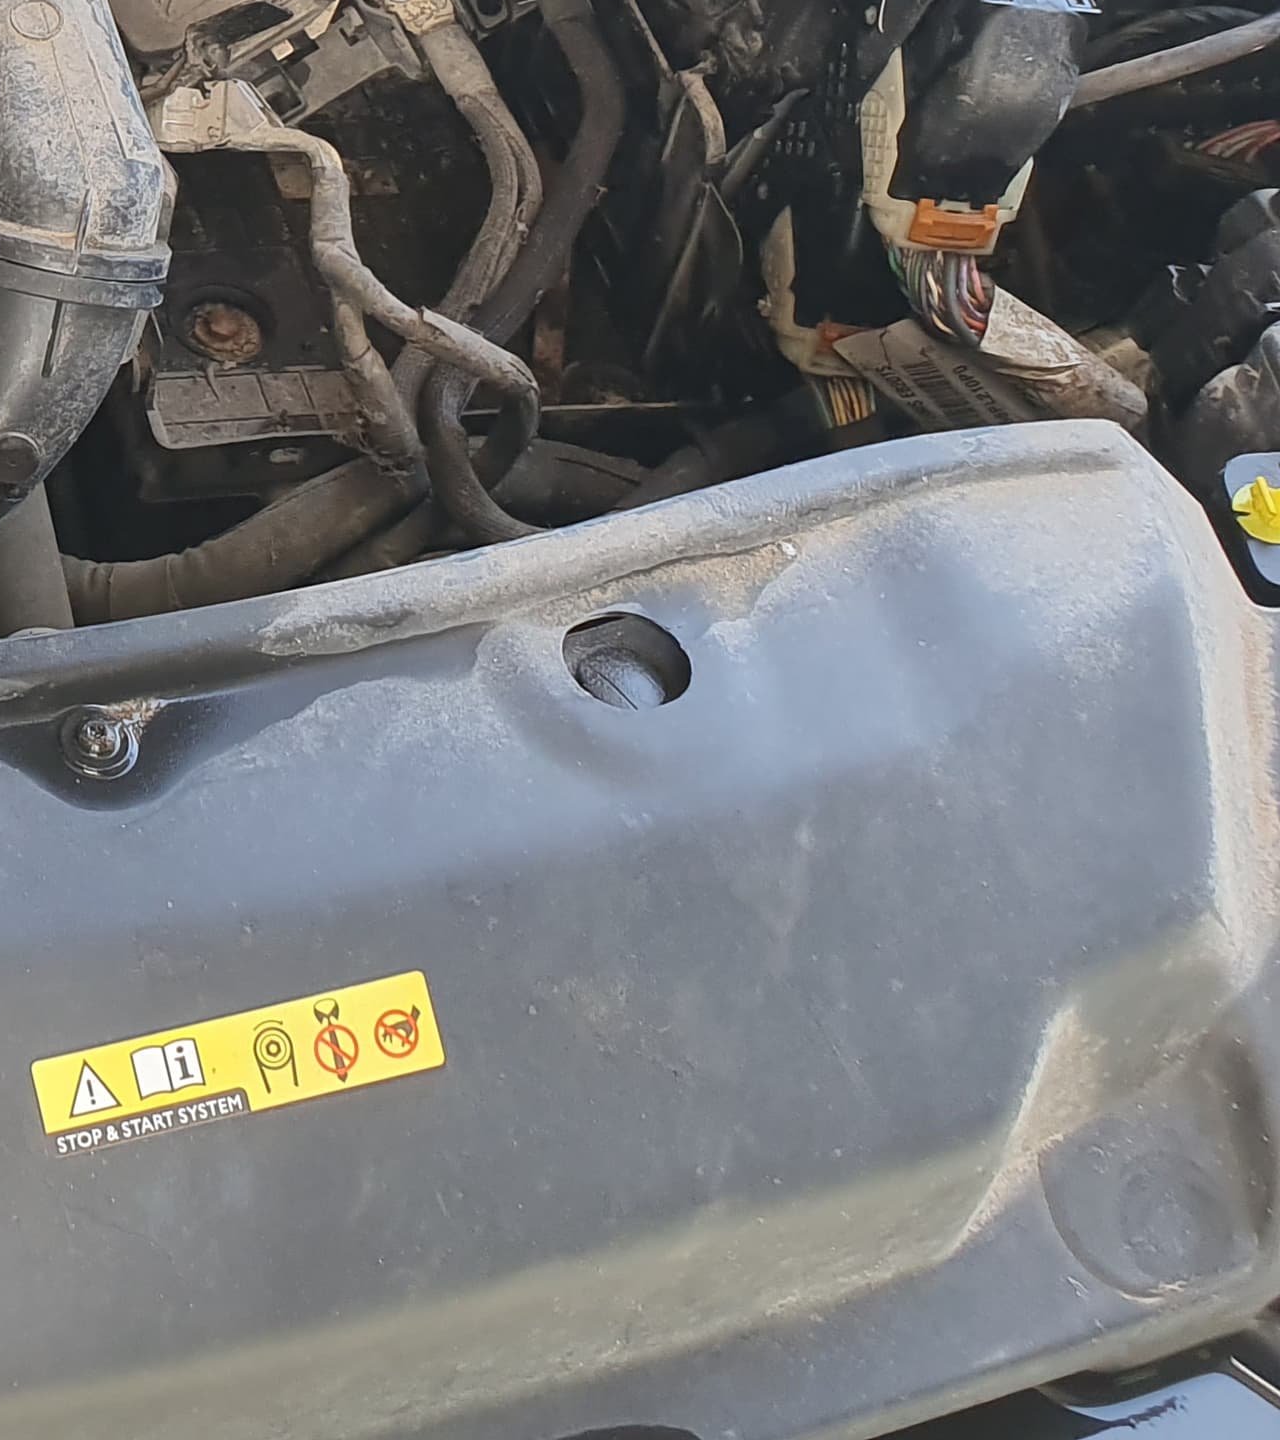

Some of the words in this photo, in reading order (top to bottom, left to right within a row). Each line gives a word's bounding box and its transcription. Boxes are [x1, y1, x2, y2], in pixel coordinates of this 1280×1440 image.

[56, 1128, 102, 1153] STOP
[106, 1125, 120, 1143] &
[122, 1111, 174, 1138] START
[179, 1095, 242, 1124] SYSTEM
